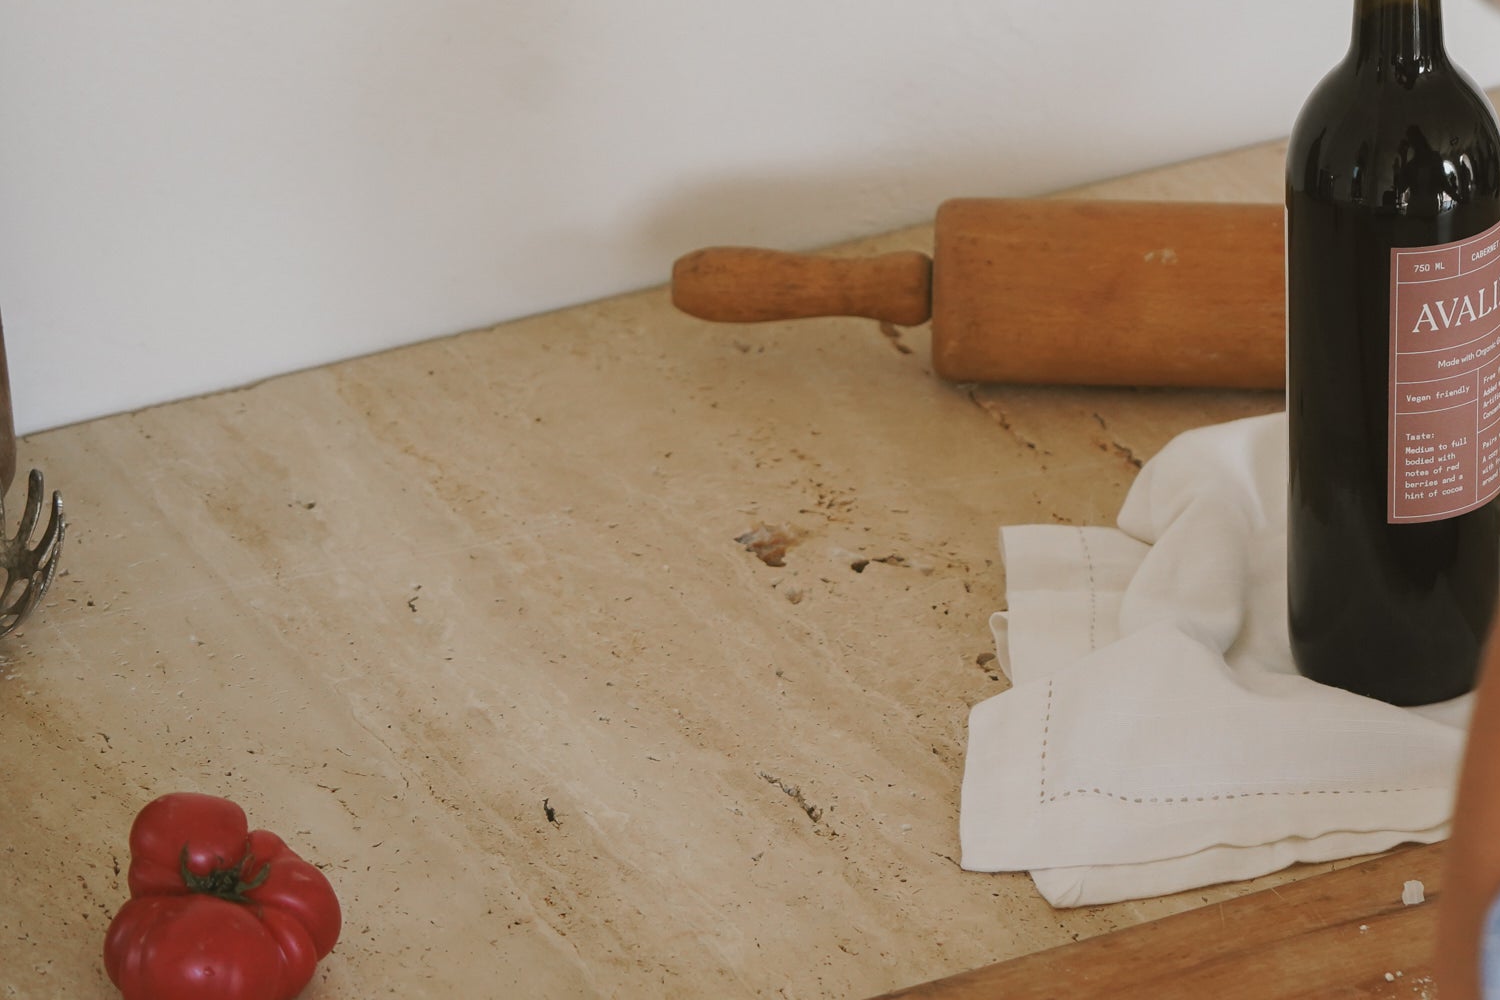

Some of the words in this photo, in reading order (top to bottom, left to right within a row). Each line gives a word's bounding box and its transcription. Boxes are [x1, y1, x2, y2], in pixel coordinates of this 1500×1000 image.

[1414, 264, 1430, 272] 750
[1435, 262, 1445, 270] ML
[1437, 357, 1460, 369] Made
[1461, 353, 1475, 364] with
[1406, 394, 1431, 404] Vegan
[1436, 385, 1470, 400] friendly
[1405, 432, 1435, 441] Taste:
[1405, 446, 1435, 454] Medium
[1438, 443, 1448, 451] to
[1451, 437, 1467, 448] full
[1405, 456, 1435, 466] bodied
[1437, 452, 1456, 462] with
[1433, 465, 1442, 475] of
[1446, 461, 1460, 472] red
[1405, 480, 1439, 489] berries
[1442, 474, 1456, 484] and
[1405, 491, 1424, 500] hint
[1428, 489, 1438, 498] of
[1441, 485, 1464, 496] cocoa
